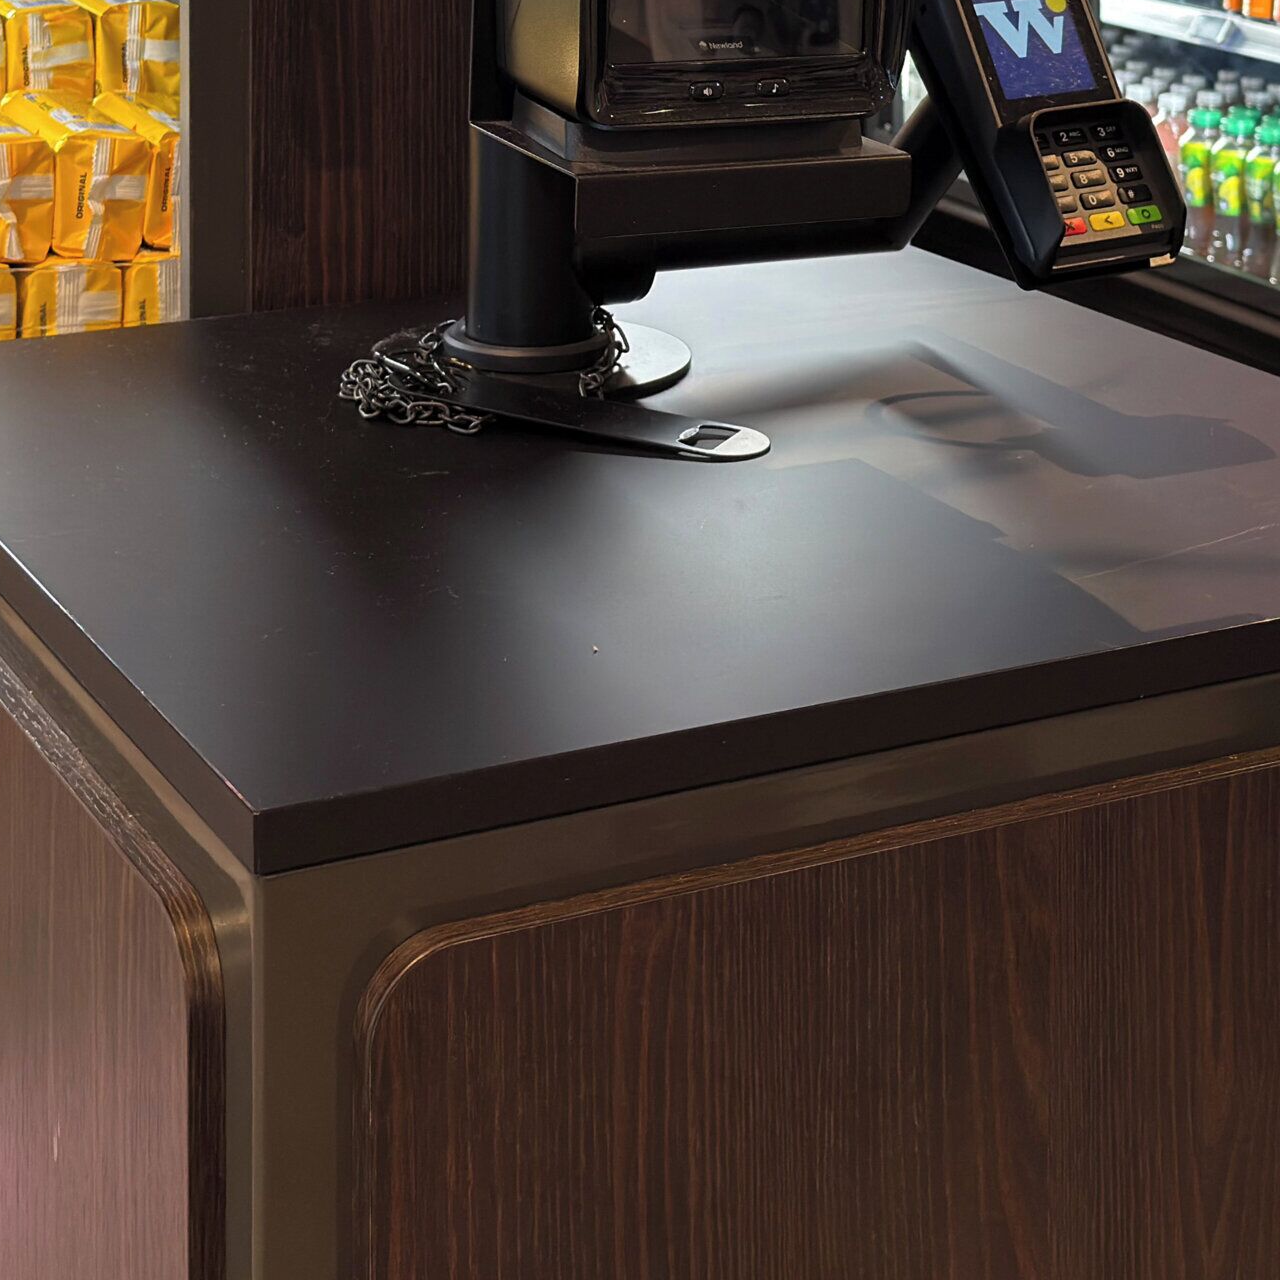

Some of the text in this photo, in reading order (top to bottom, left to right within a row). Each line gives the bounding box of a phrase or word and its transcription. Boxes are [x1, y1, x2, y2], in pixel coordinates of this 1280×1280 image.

[709, 41, 743, 50] Newland
[1059, 132, 1068, 142] 2
[1097, 127, 1105, 137] 3
[1106, 147, 1115, 158] 6
[1070, 154, 1078, 163] 5
[1116, 168, 1125, 178] 9
[1079, 173, 1088, 184] 8
[161, 167, 172, 212] ORIGINAL
[76, 172, 88, 219] ORIGINAL
[1088, 195, 1097, 205] 0
